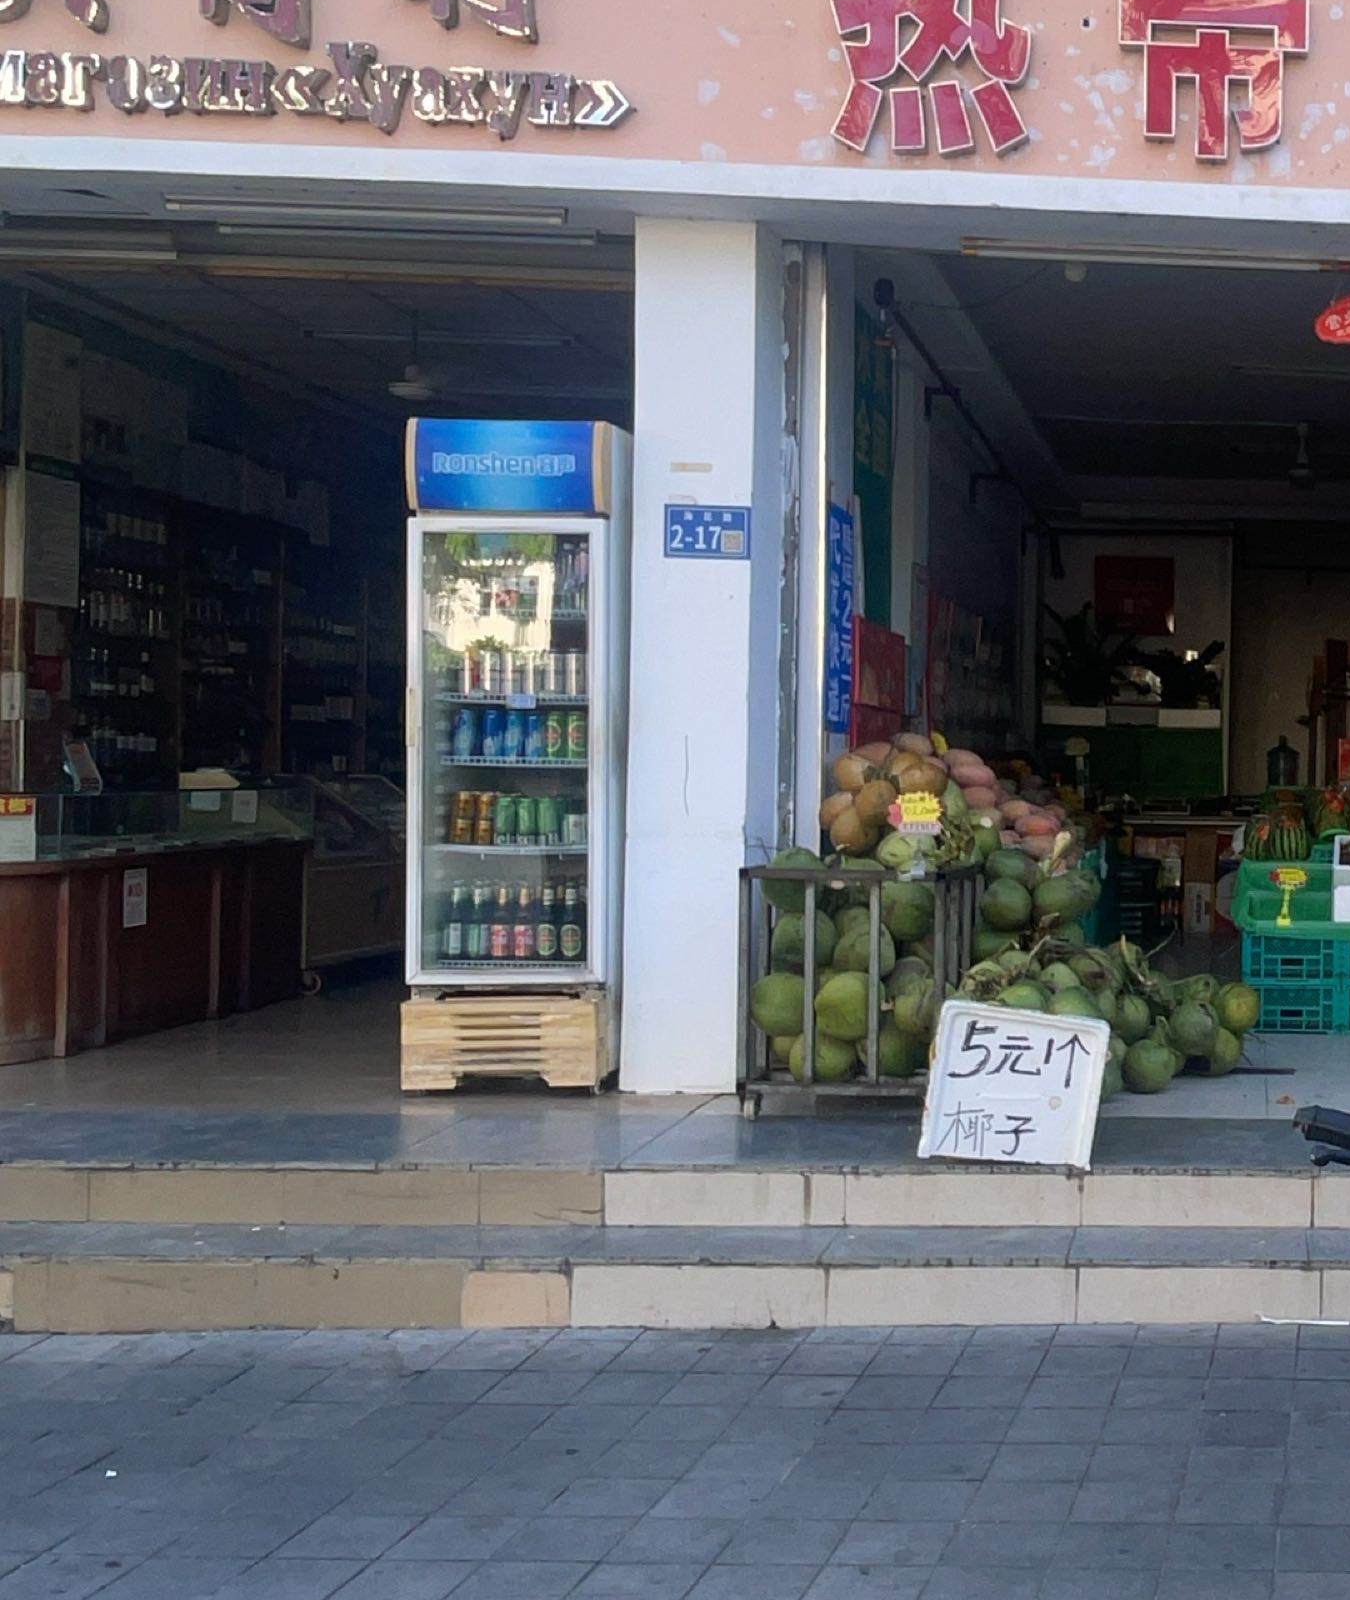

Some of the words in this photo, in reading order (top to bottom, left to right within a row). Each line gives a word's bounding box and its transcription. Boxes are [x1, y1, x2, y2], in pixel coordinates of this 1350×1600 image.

[432, 451, 534, 476] Ronshen
[670, 524, 722, 550] 2-17
[946, 1019, 1091, 1090] 5元1个
[935, 1100, 1037, 1157] 椰子
